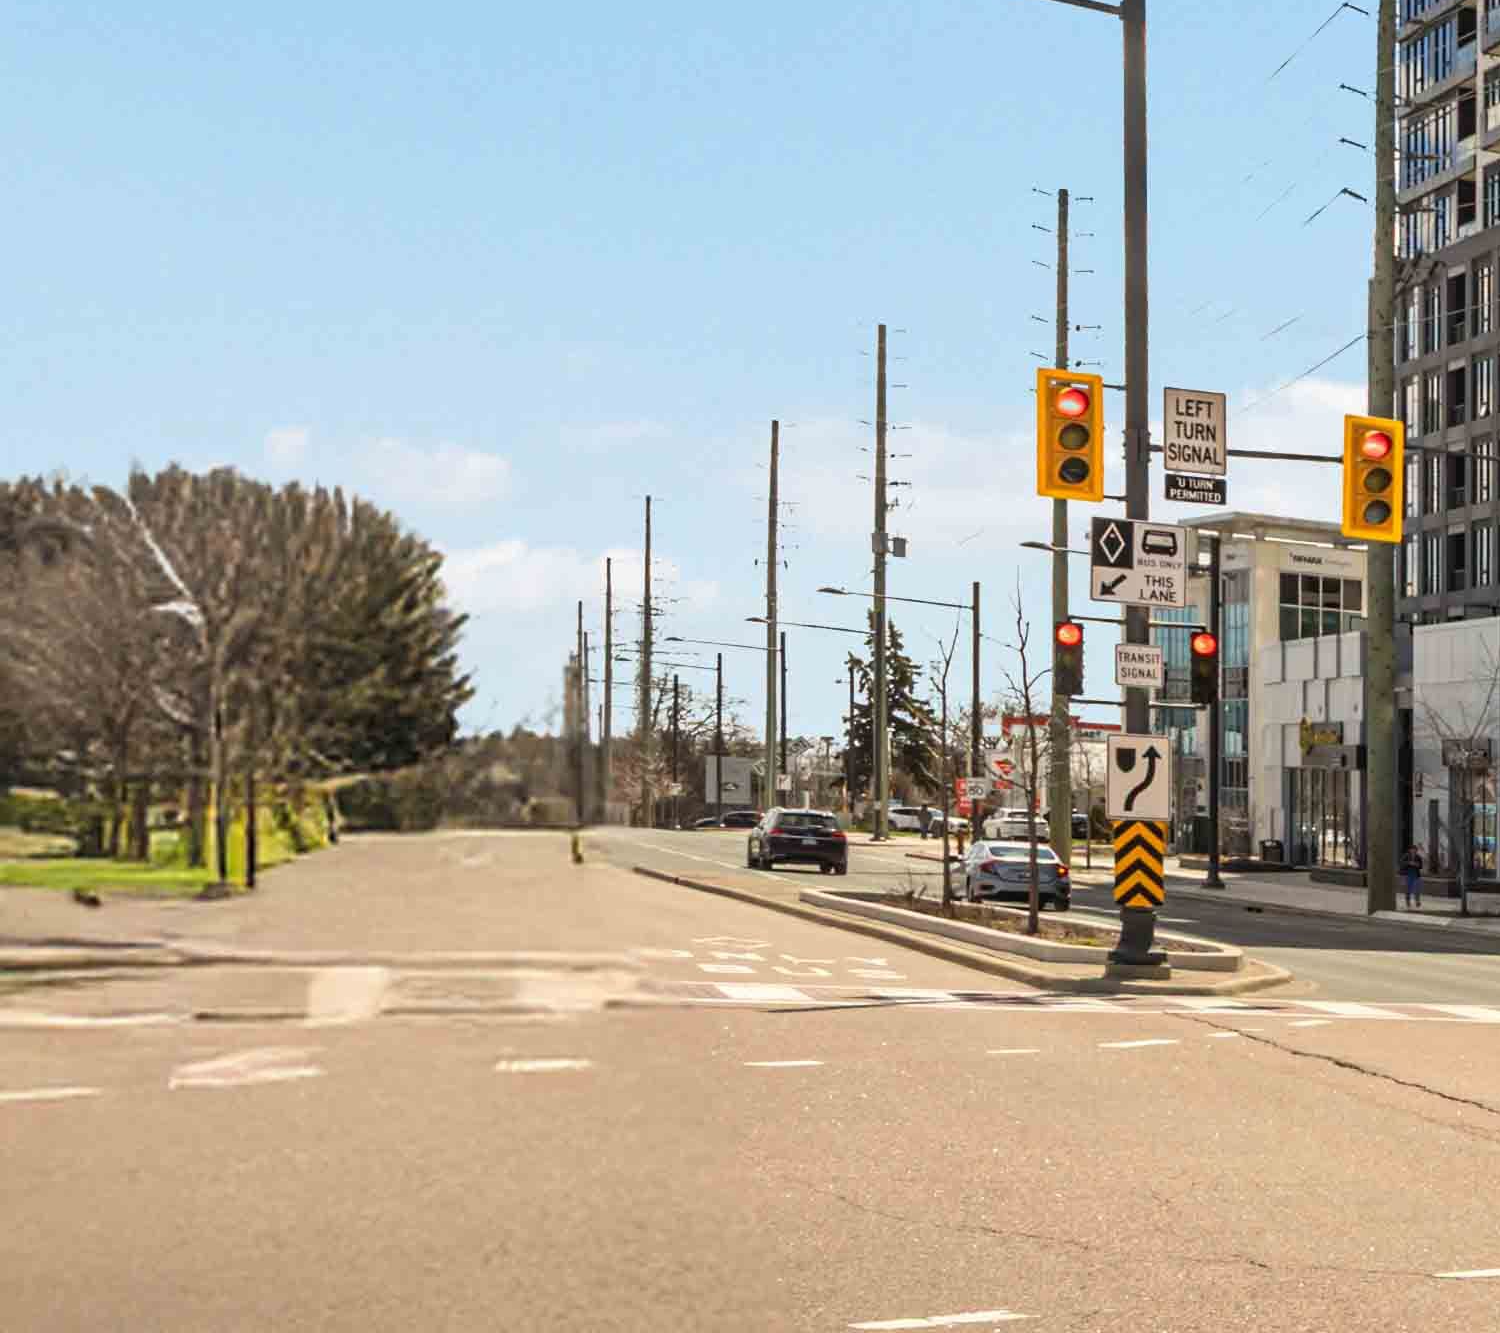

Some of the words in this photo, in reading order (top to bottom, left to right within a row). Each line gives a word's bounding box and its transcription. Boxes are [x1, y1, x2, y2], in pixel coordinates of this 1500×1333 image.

[1175, 397, 1215, 418] LEFT
[1174, 421, 1216, 443] TURN
[1167, 442, 1222, 466] SIGNAL
[1169, 488, 1222, 503] PERMITTED
[1144, 575, 1174, 588] THIS
[1138, 589, 1176, 603] LANE
[1118, 652, 1161, 664] TRANSIT
[1120, 667, 1158, 679] SIGNAL
